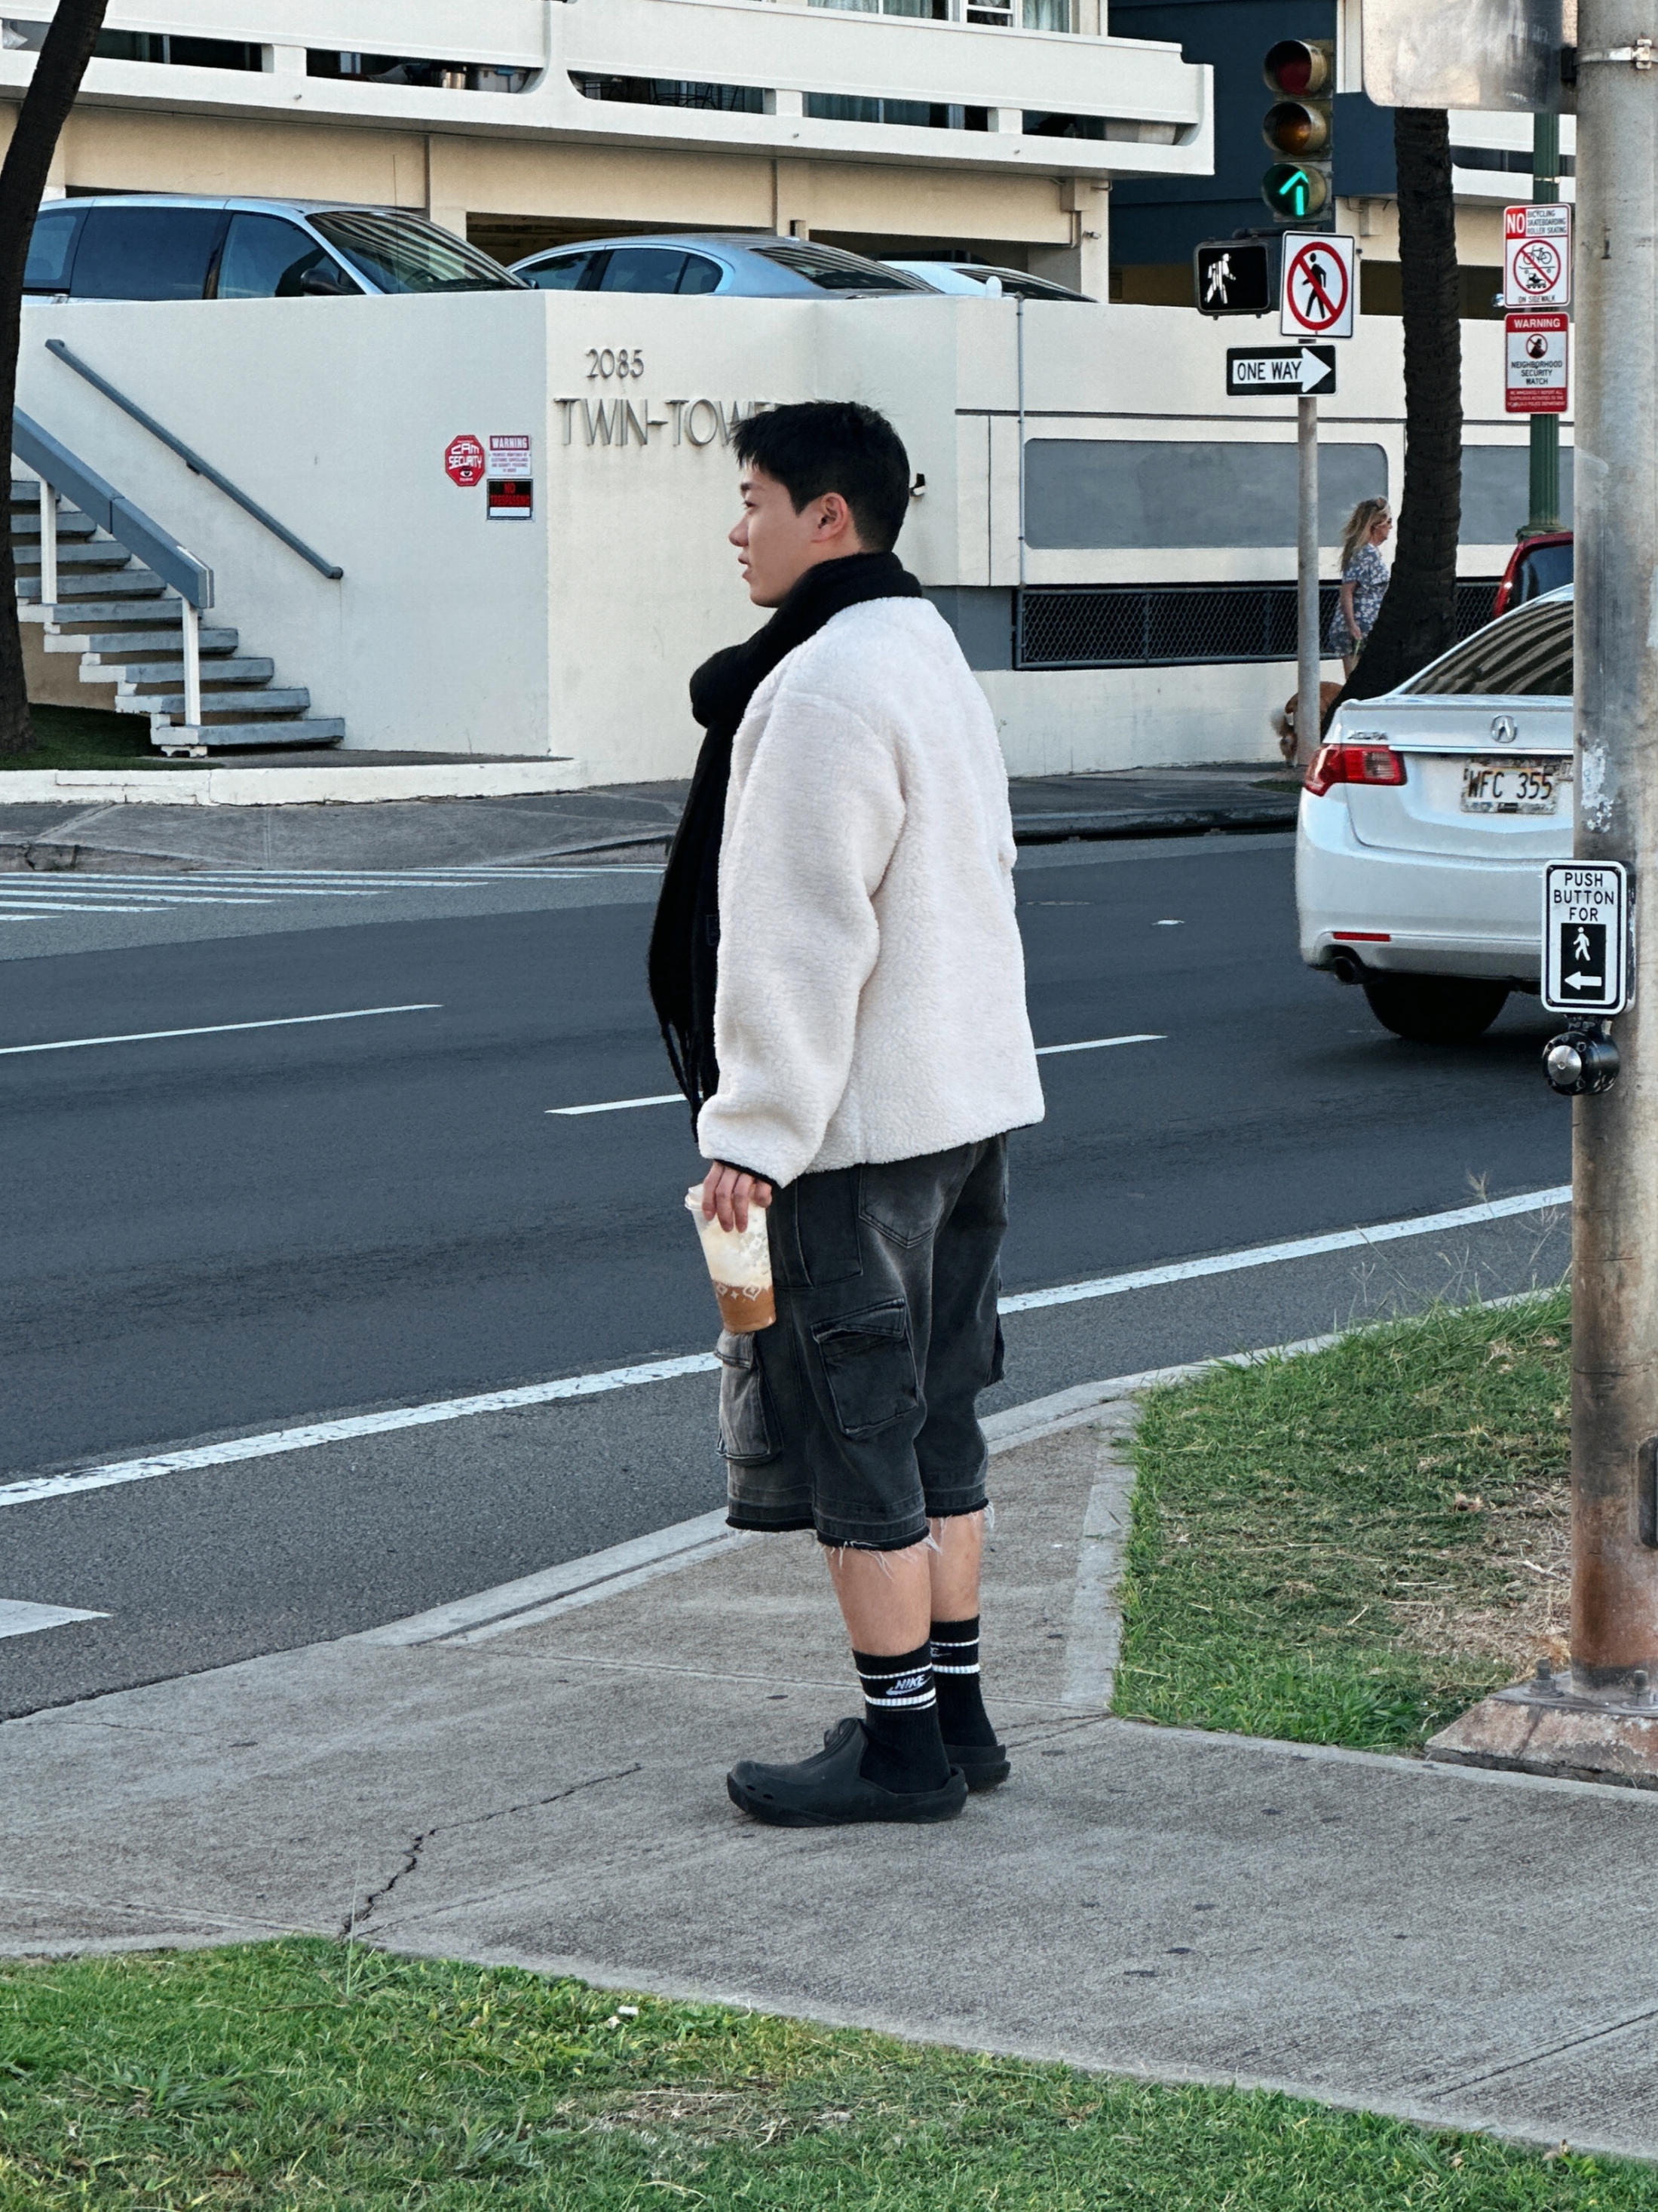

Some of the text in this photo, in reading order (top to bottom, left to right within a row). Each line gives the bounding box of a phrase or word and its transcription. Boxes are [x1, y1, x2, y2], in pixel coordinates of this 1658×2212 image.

[1527, 210, 1555, 218] BICYCLING
[1507, 213, 1525, 234] NO
[1527, 218, 1567, 226] SKATEBOARDING
[1514, 318, 1561, 328] WARNING
[585, 348, 644, 378] 2085
[1511, 360, 1563, 369] NEIGHBORHOOD
[1237, 360, 1302, 381] ONE WAY
[492, 437, 528, 449] WARNING
[449, 456, 483, 470] SECURITY
[504, 483, 516, 494] NO
[1468, 771, 1552, 799] WFC 355
[1565, 873, 1603, 887] PUSH
[1554, 889, 1614, 904] BUTTON
[1569, 907, 1598, 922] FOR
[894, 1674, 926, 1690] NIKE
